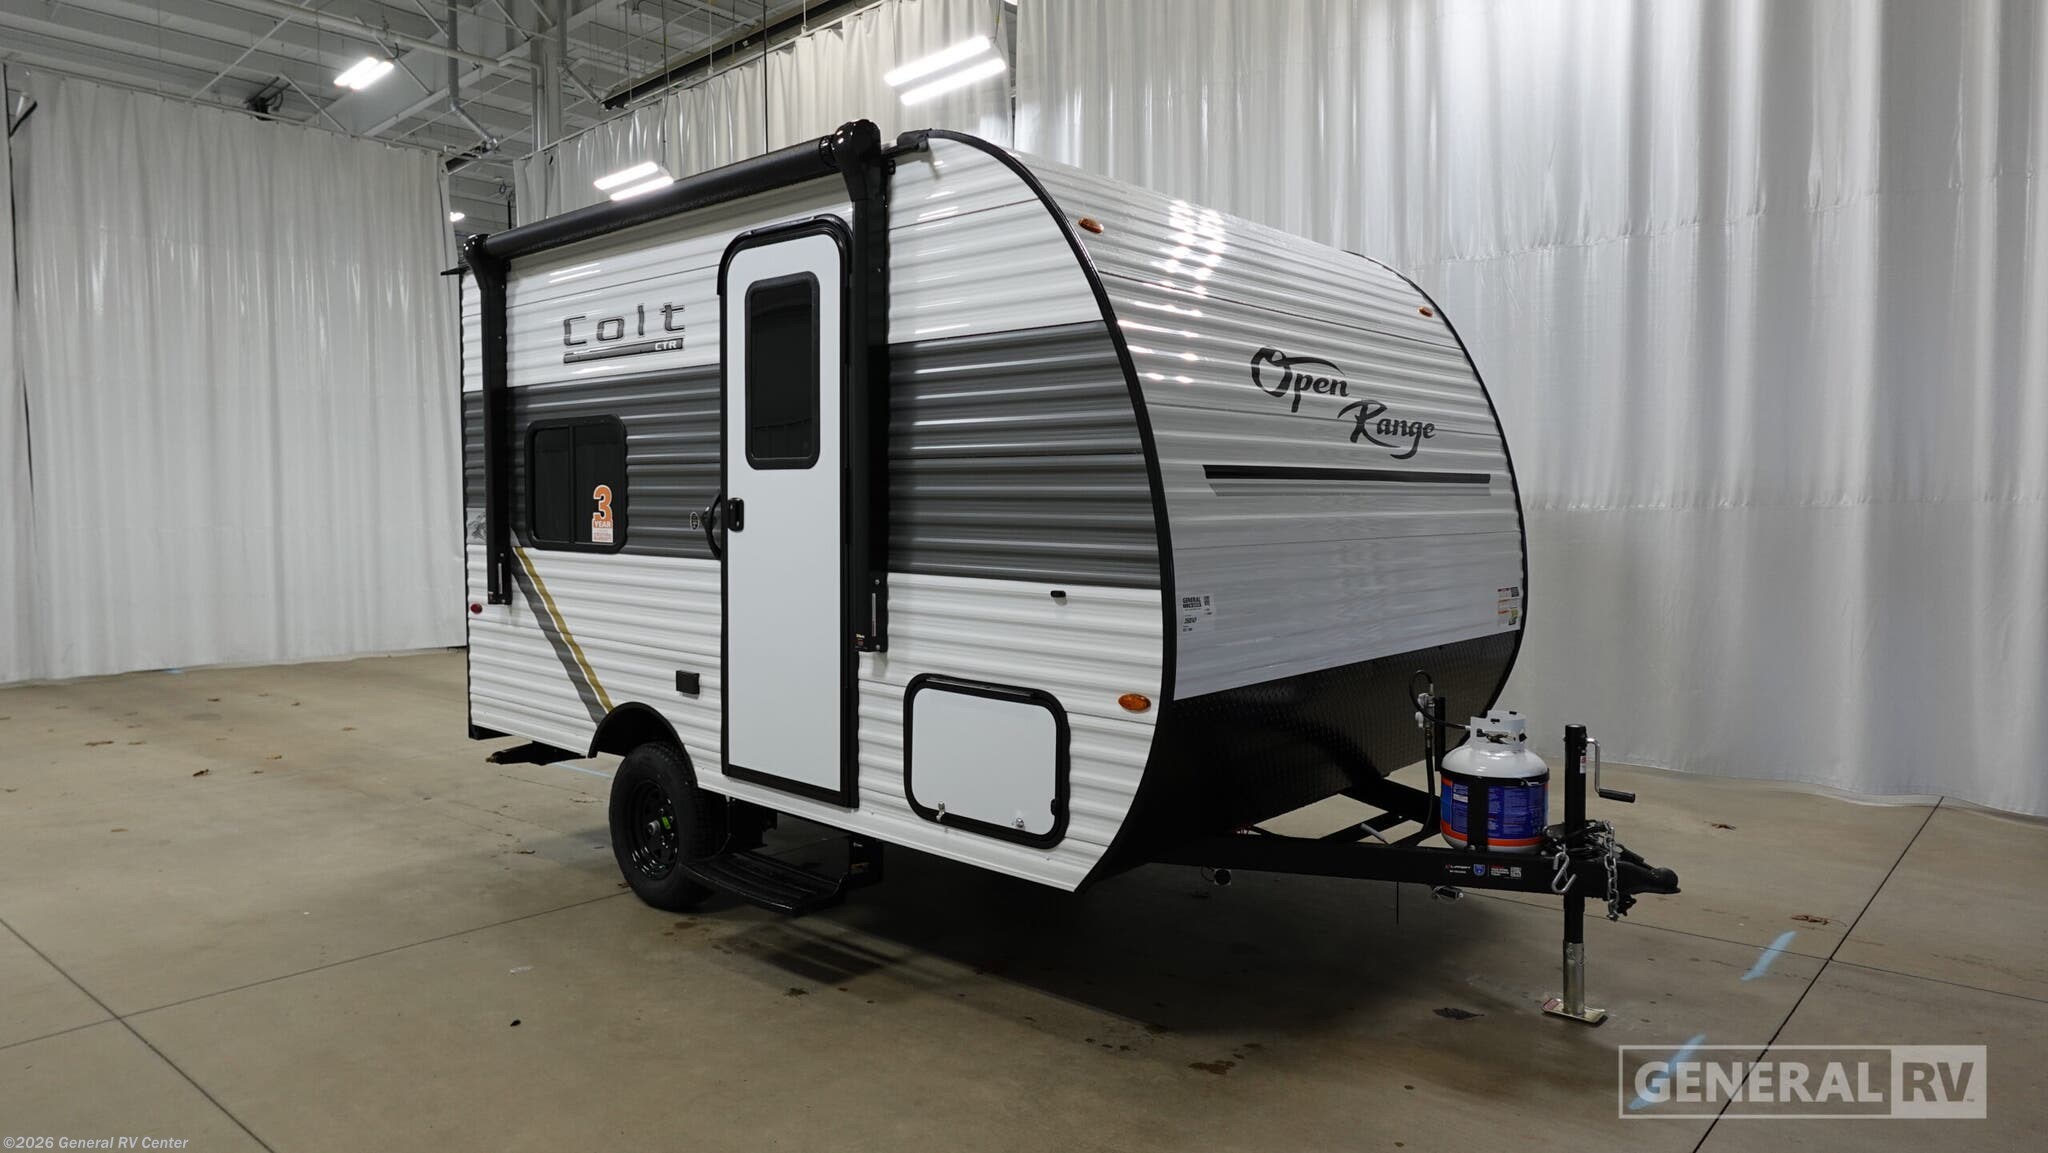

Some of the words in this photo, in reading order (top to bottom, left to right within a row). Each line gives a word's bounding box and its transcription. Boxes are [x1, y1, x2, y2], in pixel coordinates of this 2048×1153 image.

[563, 302, 686, 346] Colt
[654, 340, 678, 351] CTR
[1250, 347, 1350, 413] Open
[1337, 400, 1436, 460] Range
[593, 485, 612, 521] 3
